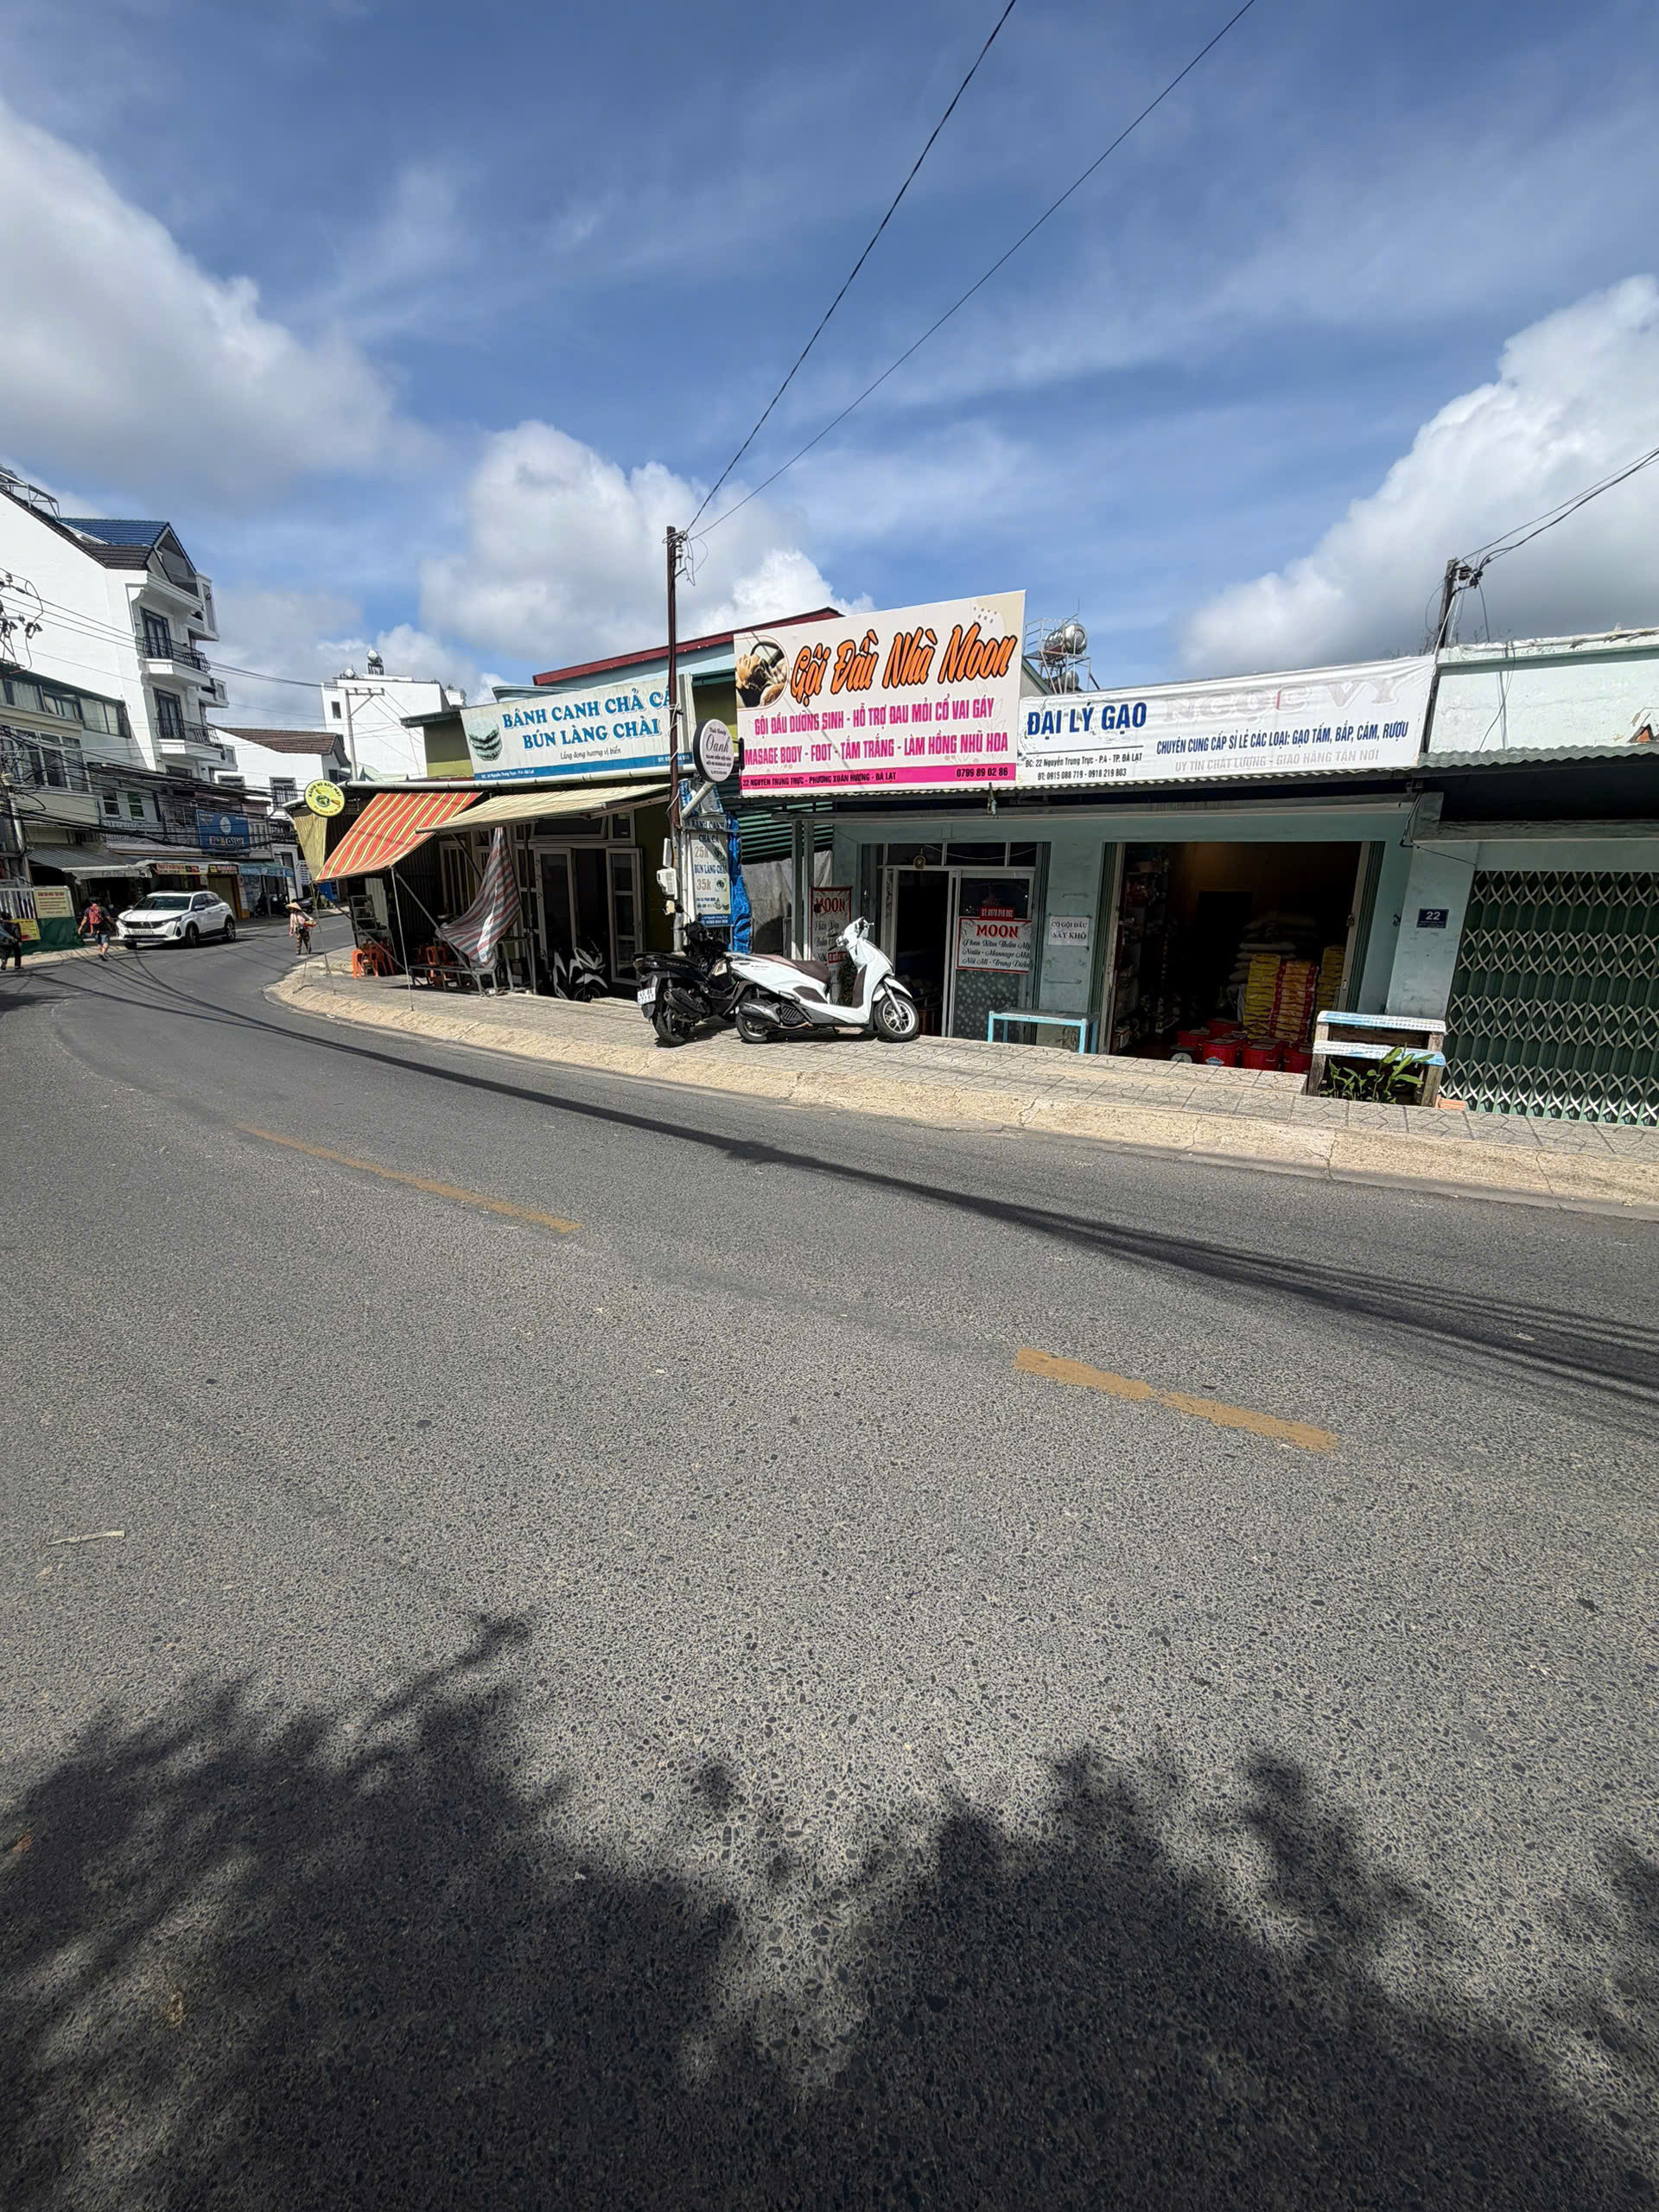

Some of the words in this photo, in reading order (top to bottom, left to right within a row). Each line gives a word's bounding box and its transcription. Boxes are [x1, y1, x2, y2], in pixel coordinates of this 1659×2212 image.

[791, 644, 831, 707] Gội
[830, 629, 879, 694] Đầu
[882, 626, 938, 688] Nhà
[938, 622, 1018, 683] Moon
[502, 708, 547, 728] BÁNH
[551, 701, 600, 721] CANH
[605, 688, 644, 714] CHẢ
[754, 715, 768, 739] GỘI
[790, 710, 819, 733] DƯỠNG
[822, 711, 843, 730] SINH
[853, 702, 865, 728] HỖ
[868, 704, 887, 729] TRỢ
[890, 705, 908, 724] ĐAU
[912, 697, 932, 722] MỎI
[935, 693, 949, 721] CỔ
[952, 700, 969, 720] VAI
[973, 695, 994, 718] GÁY
[1027, 710, 1062, 740] ĐẠI
[1069, 702, 1094, 733] LÝ
[1101, 702, 1147, 734] GẠO
[522, 729, 556, 749] BÚN
[560, 725, 607, 745] LÀNG
[613, 715, 659, 738] CHÀI
[745, 747, 778, 765] MASAGE
[780, 746, 802, 764] BODY
[810, 744, 832, 761] FOOT
[841, 735, 861, 760] TẮM
[863, 733, 894, 758] TRẮNG
[905, 734, 925, 755] LÀM
[928, 729, 957, 754] HỒNG
[960, 729, 982, 753] NHŨ
[987, 732, 1008, 752] HOA
[1157, 736, 1186, 754] CHUYÊN
[1188, 737, 1209, 753] CUNG
[1211, 730, 1227, 750] CẤP
[1229, 729, 1238, 749] SỈ
[1239, 728, 1249, 748] LẺ
[1250, 729, 1267, 747] CÁC
[1269, 730, 1290, 749] LOẠI:
[1293, 729, 1310, 747] GẠO
[1313, 722, 1332, 743] TẤM,
[1335, 720, 1354, 742] BẮP,
[1357, 721, 1379, 741] CÁM,
[1382, 720, 1408, 741] RƯỢU
[791, 777, 804, 785] TRỰC
[833, 774, 849, 783] XUÂN
[886, 772, 896, 781] LẠT
[999, 767, 1007, 776] 86
[1082, 757, 1093, 766] Trực
[1132, 753, 1142, 763] LẠT
[1175, 761, 1186, 772] UY
[1277, 753, 1300, 765] GIAO
[976, 925, 1019, 938] MOON
